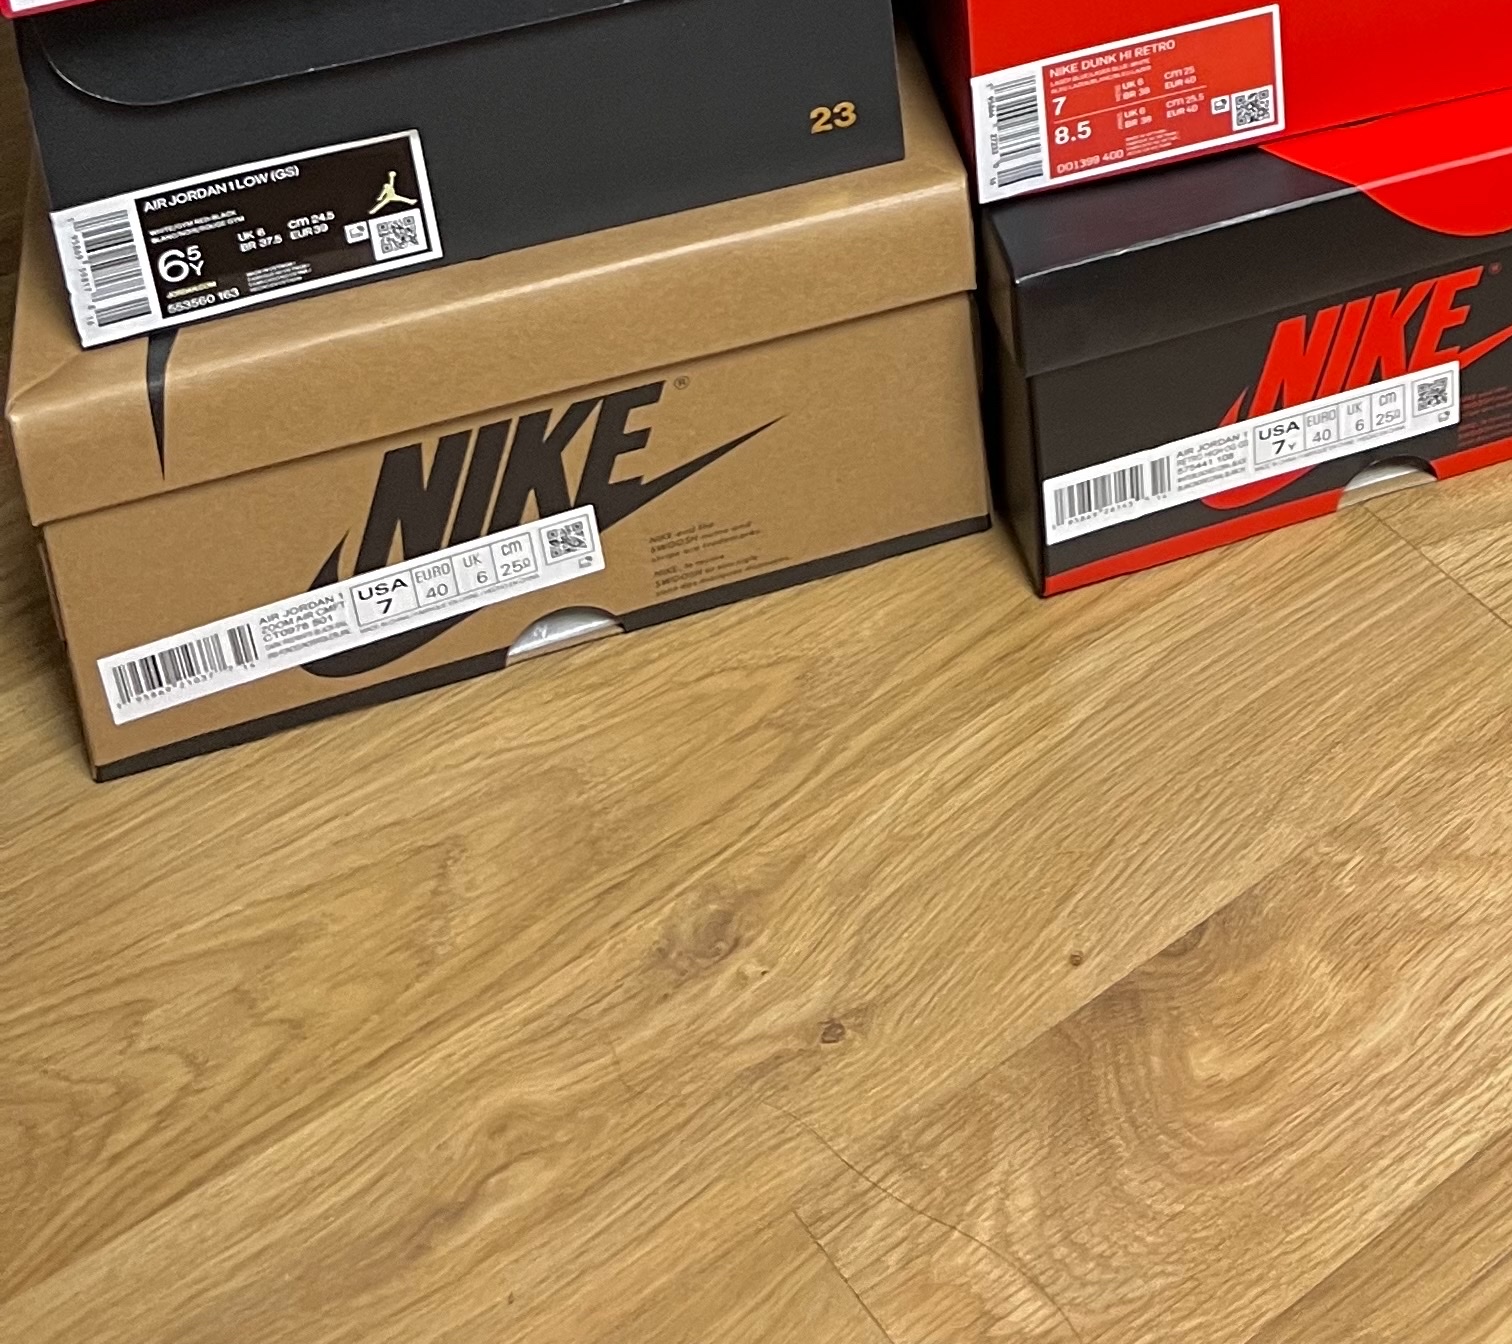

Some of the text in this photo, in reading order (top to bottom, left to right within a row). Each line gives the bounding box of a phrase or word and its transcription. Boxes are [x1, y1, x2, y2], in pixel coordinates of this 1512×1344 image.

[1049, 61, 1080, 79] NIKE
[1081, 53, 1118, 71] DUNK
[1119, 48, 1134, 62] HI
[1134, 38, 1177, 58] RETRO
[1052, 96, 1067, 116] 7
[809, 101, 858, 135] 23
[1054, 119, 1092, 145] 8.5
[143, 198, 168, 213] AIR
[168, 182, 228, 208] JORDAN
[236, 173, 270, 191] LOW
[269, 162, 300, 183] (GS)
[286, 217, 310, 231] cm
[289, 226, 313, 241] EUR
[236, 230, 256, 242] UK
[257, 233, 283, 250] 37.5
[1249, 264, 1485, 419] NIKE
[1346, 401, 1362, 416] UK
[1378, 391, 1398, 407] cm
[1306, 408, 1337, 430] EURO
[1354, 419, 1365, 432] 6
[1259, 420, 1301, 441] USA
[1312, 428, 1332, 444] 40
[1176, 444, 1196, 459] AIR
[1196, 433, 1240, 454] JORDAN
[1271, 438, 1287, 456] 7
[354, 378, 667, 575] NIKE
[499, 539, 524, 558] cm
[462, 552, 484, 569] UK
[414, 560, 452, 587] EURO
[475, 570, 489, 586] 6
[357, 577, 409, 602] USA
[424, 582, 450, 601] 40
[259, 608, 283, 626] AIR
[282, 593, 335, 619] JORDAN
[375, 597, 395, 615] 7
